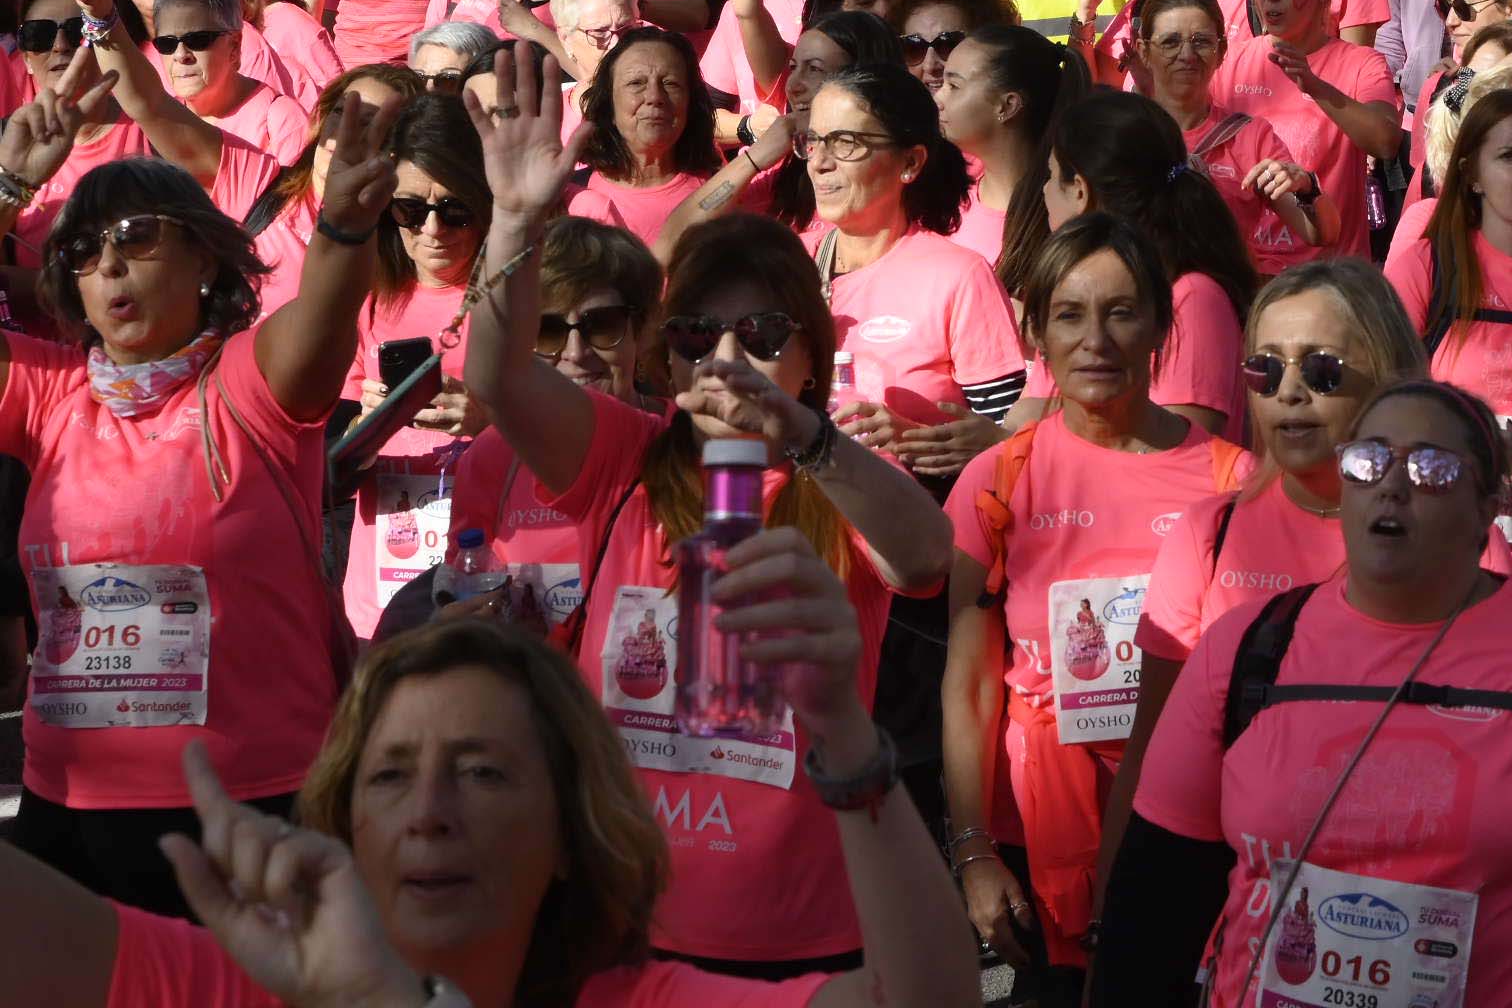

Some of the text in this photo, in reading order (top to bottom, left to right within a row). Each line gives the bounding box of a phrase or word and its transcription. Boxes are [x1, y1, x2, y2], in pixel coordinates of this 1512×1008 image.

[1030, 509, 1095, 530] OYSHO
[1220, 570, 1294, 592] OYSHO
[84, 624, 142, 648] 016
[85, 655, 132, 671] 23138
[89, 678, 101, 688] DE
[103, 678, 119, 688] LA
[120, 675, 158, 687] MUJER
[161, 678, 187, 687] 2023
[131, 699, 192, 713] Santander
[1079, 693, 1129, 705] CARRERA
[624, 714, 678, 730] CARRERA
[1077, 714, 1131, 730] OYSHO
[726, 749, 784, 770] Santander
[1325, 903, 1459, 933] ASTURIANA SUMA
[1320, 950, 1391, 986] 016
[1323, 986, 1378, 1008] 20339
